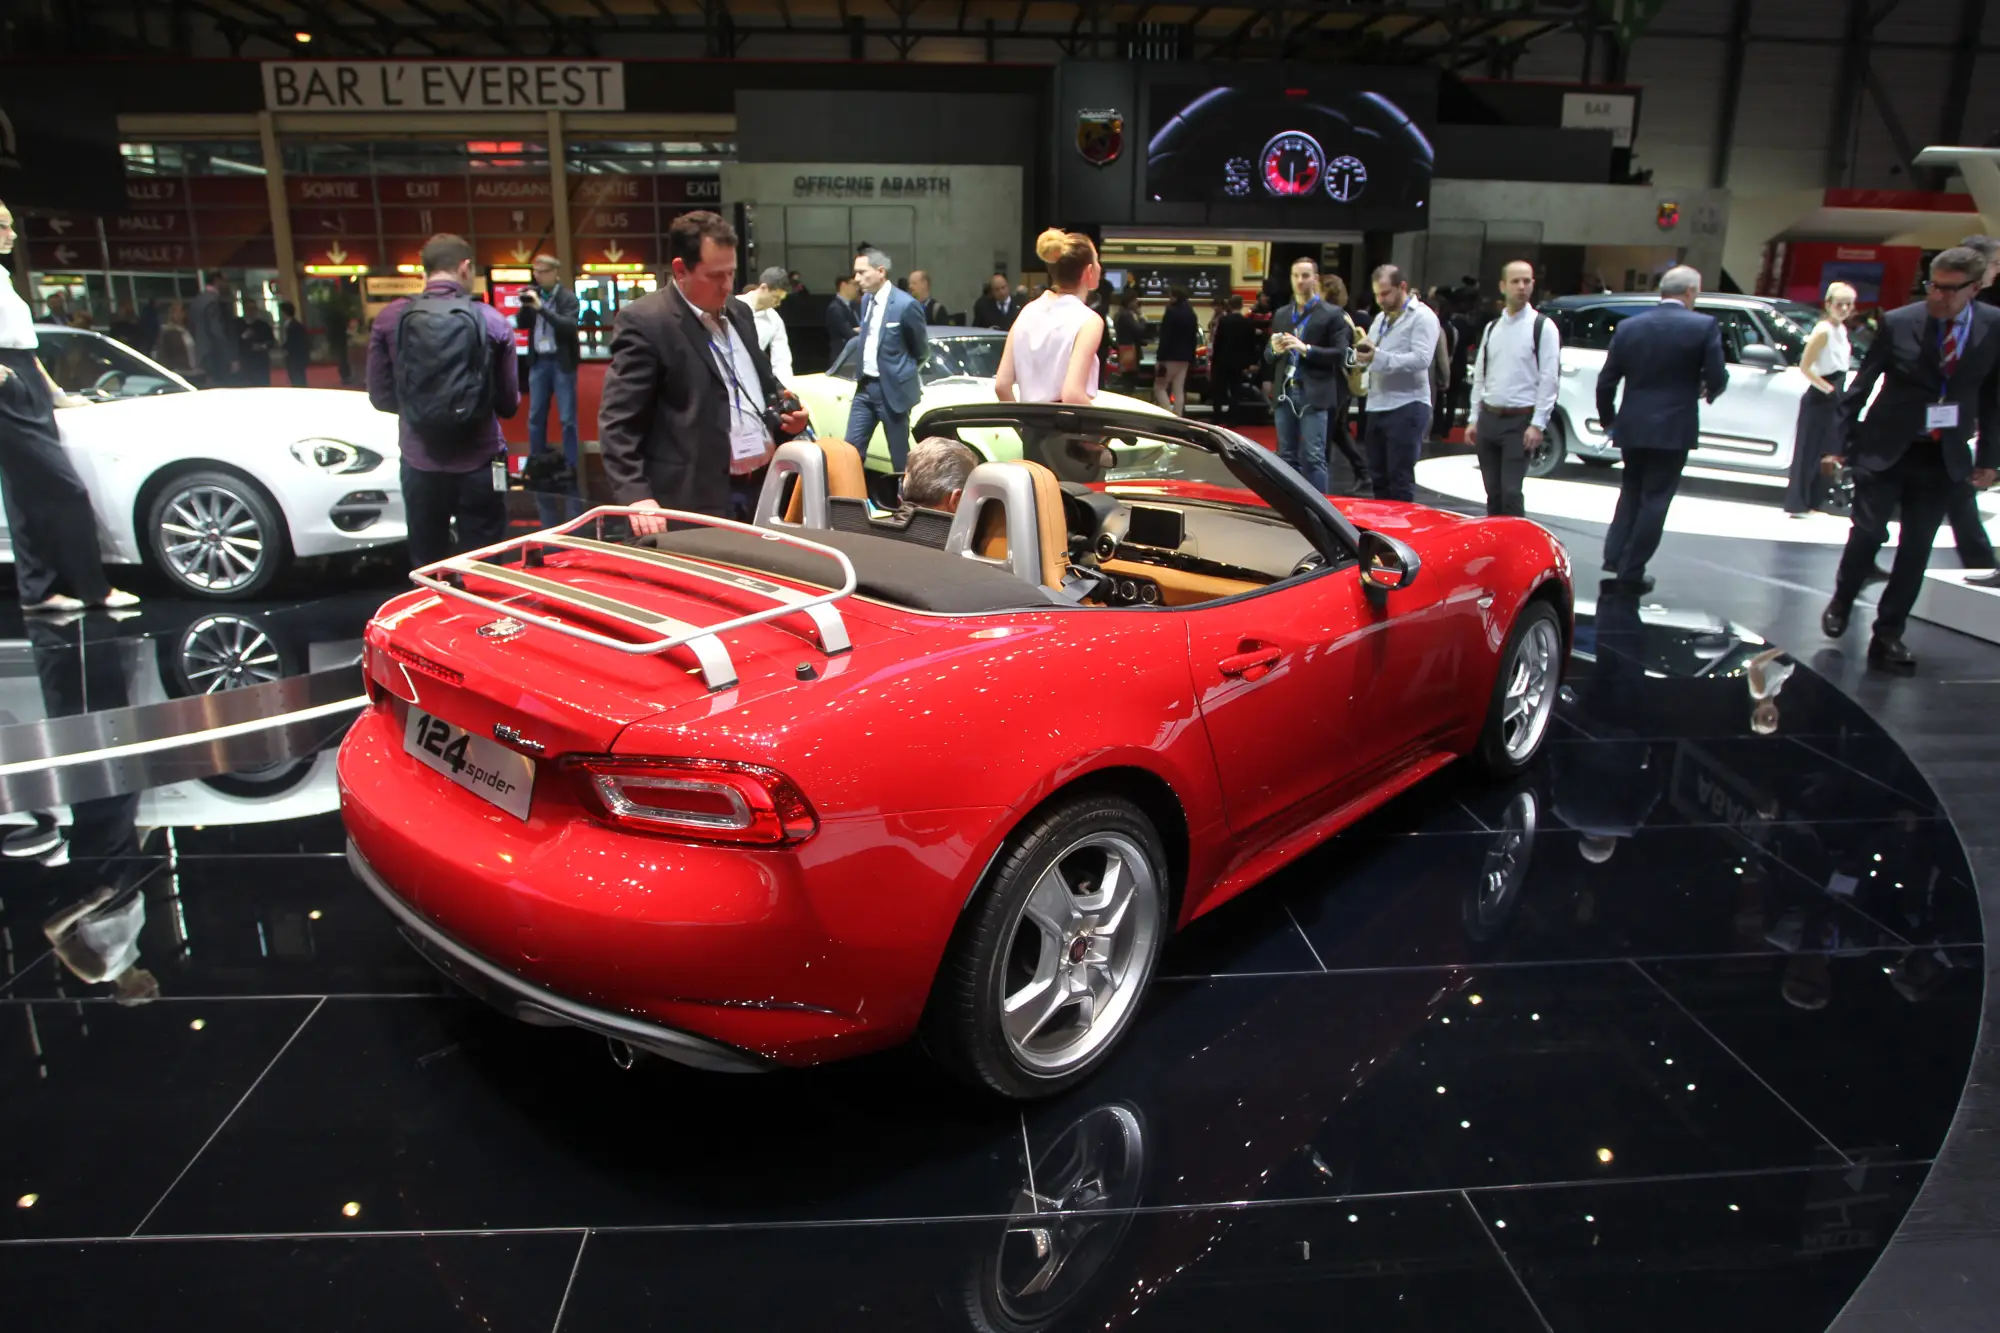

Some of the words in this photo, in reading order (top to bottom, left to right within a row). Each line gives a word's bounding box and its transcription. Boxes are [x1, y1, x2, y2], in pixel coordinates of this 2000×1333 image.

[273, 66, 364, 107] BAR
[1584, 101, 1611, 116] BAR
[126, 182, 162, 199] LLE
[301, 181, 360, 198] SORTIE
[405, 181, 441, 198] EXIT
[582, 181, 639, 197] SORTIE
[686, 181, 720, 197] EXIT
[794, 175, 875, 191] OFFICINE
[880, 175, 951, 191] ABARTH
[118, 215, 164, 231] HALL
[166, 214, 176, 231] 7
[596, 212, 629, 228] BUS
[118, 246, 172, 262] HALLE
[416, 713, 470, 774] 124
[465, 763, 516, 795] spider
